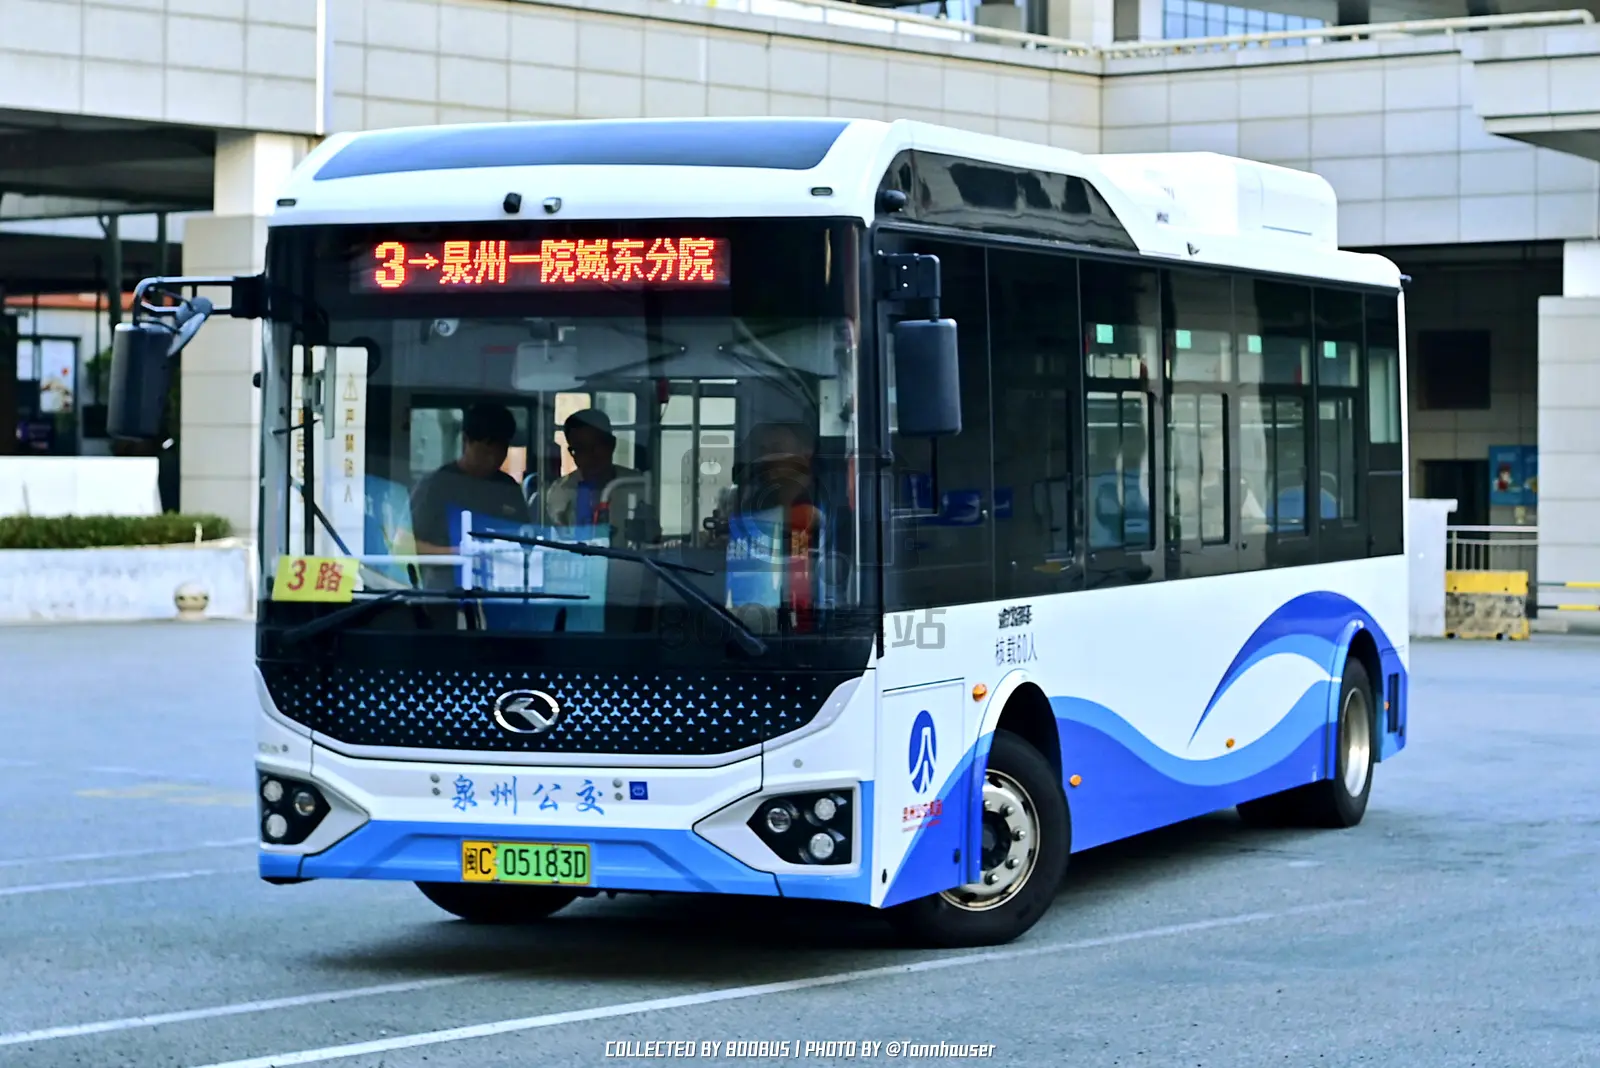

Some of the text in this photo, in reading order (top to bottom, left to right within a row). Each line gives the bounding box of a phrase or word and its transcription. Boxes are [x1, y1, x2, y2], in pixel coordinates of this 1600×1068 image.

[375, 237, 715, 288] 3 泉州一院城东分院
[287, 559, 344, 592] 3路
[451, 774, 606, 816] 泉州公交
[503, 848, 587, 879] 05183D
